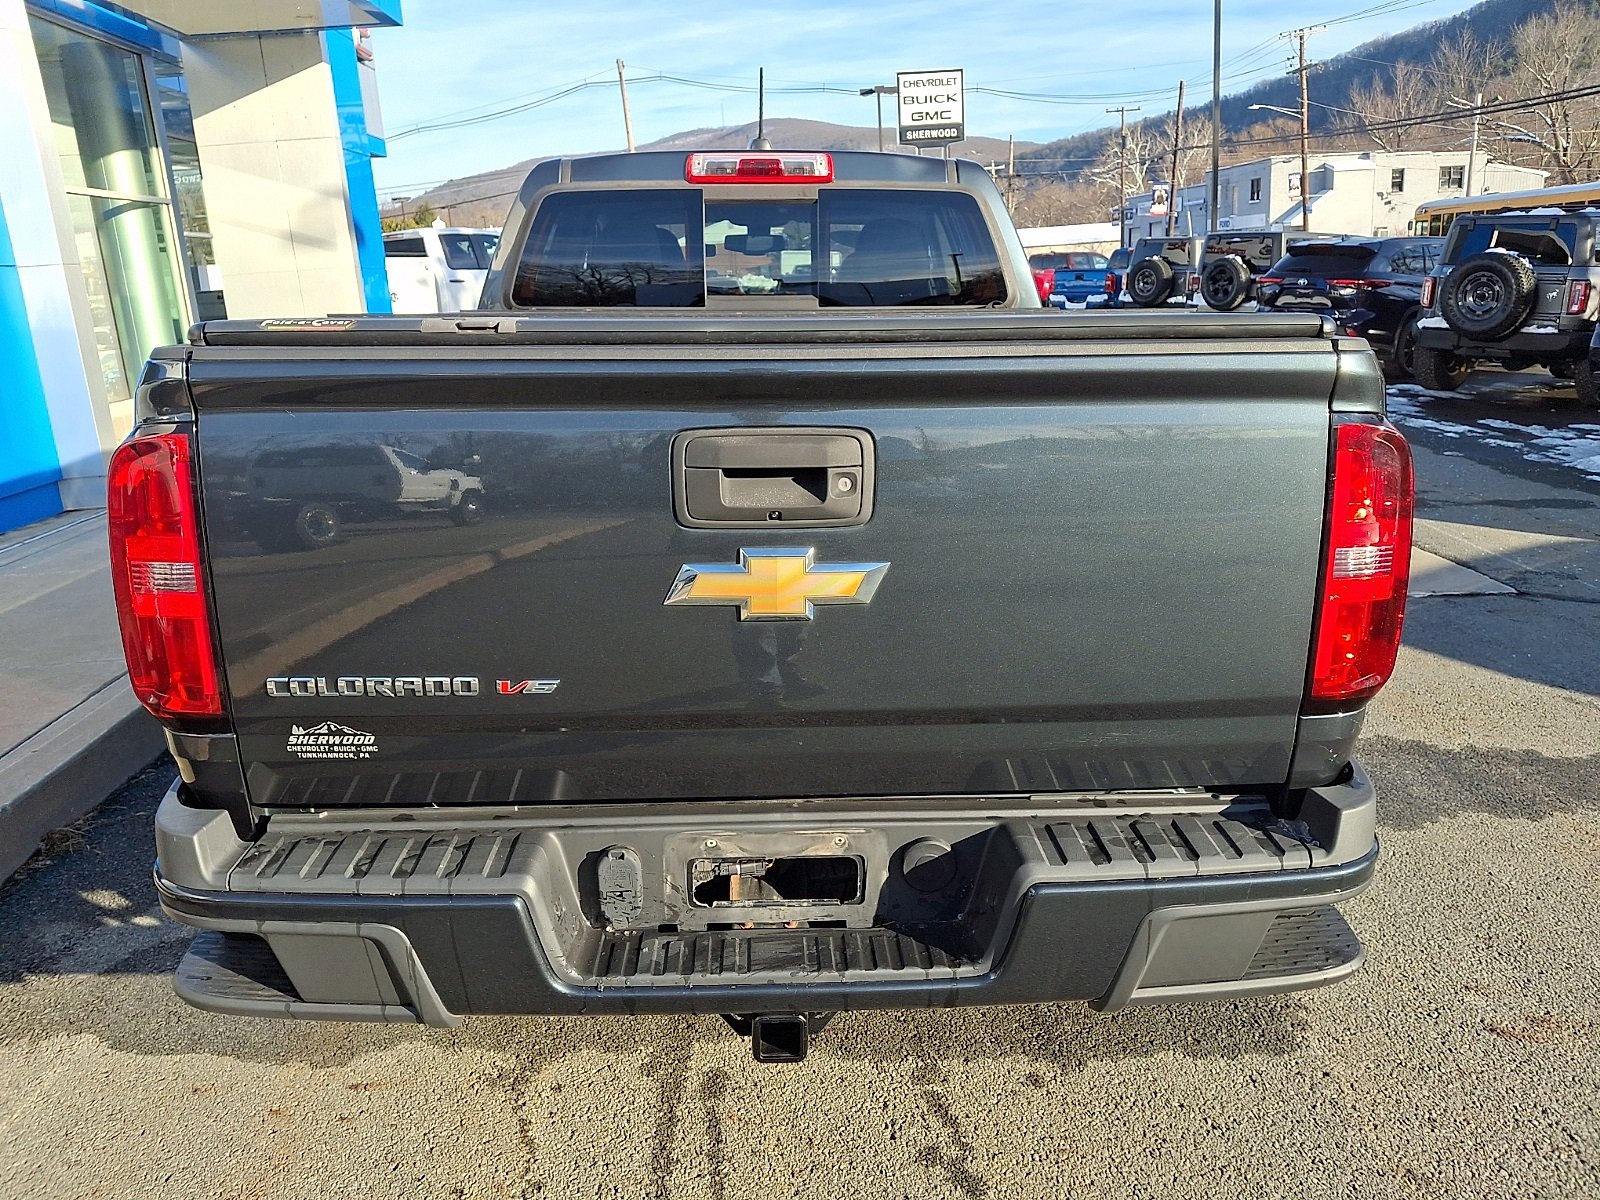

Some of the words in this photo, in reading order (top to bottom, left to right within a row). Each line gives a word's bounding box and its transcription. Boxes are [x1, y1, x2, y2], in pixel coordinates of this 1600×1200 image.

[903, 77, 957, 88] CHEVROLET
[903, 93, 957, 105] BUICK
[911, 110, 952, 121] GMC
[906, 128, 958, 140] SHERWOOD
[266, 676, 479, 697] COLORADO
[496, 679, 560, 695] V6
[287, 735, 376, 745] SHERWOOD
